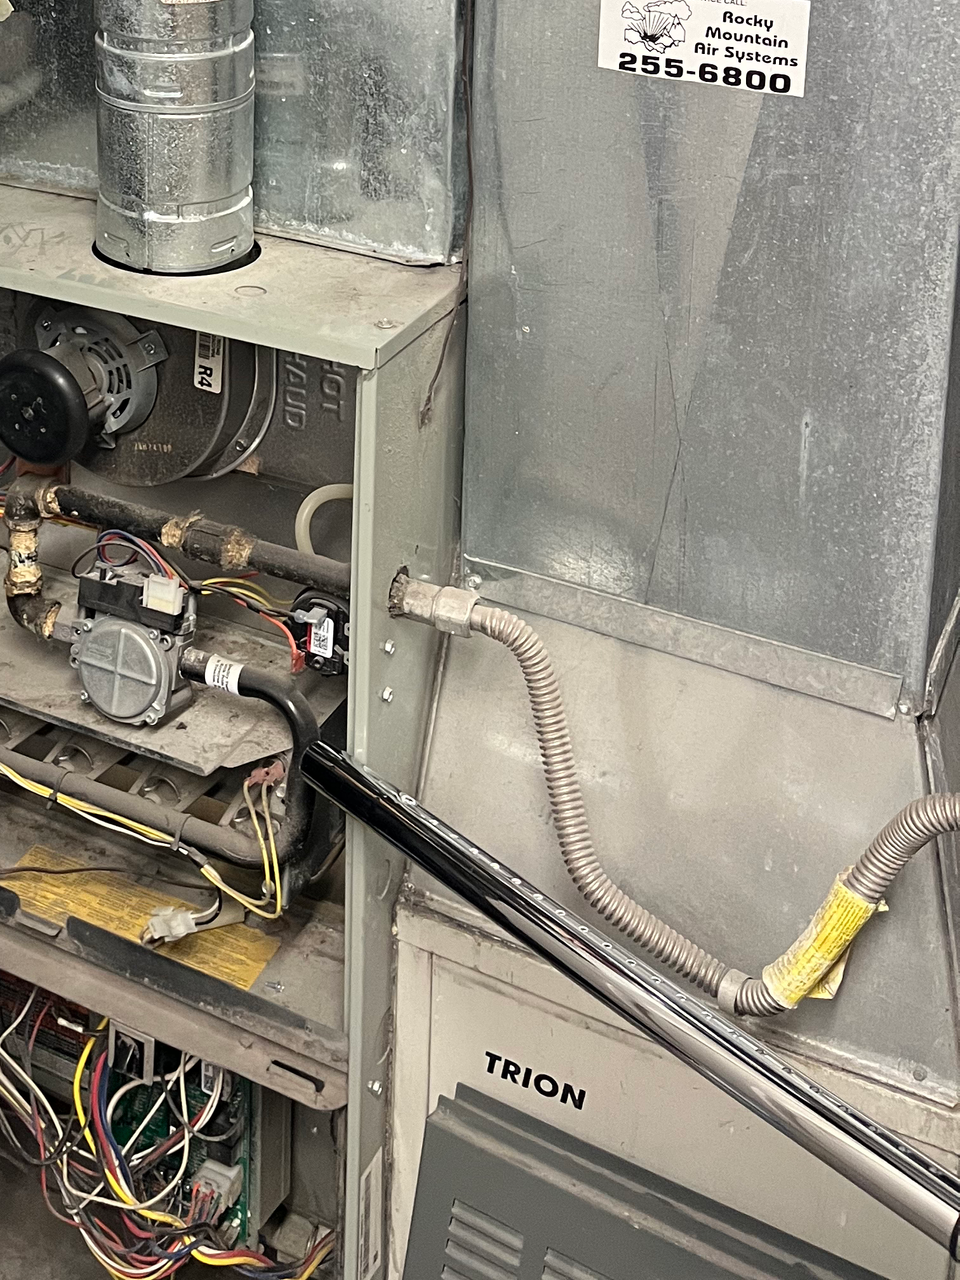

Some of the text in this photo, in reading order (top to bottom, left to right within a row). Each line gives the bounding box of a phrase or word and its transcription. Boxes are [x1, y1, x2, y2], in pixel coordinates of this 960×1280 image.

[722, 10, 774, 32] Rocky
[705, 26, 788, 48] Mountain
[694, 42, 798, 70] Air Systems
[618, 51, 791, 95] 255-6800
[197, 364, 213, 389] R4
[485, 1051, 586, 1110] TRION
